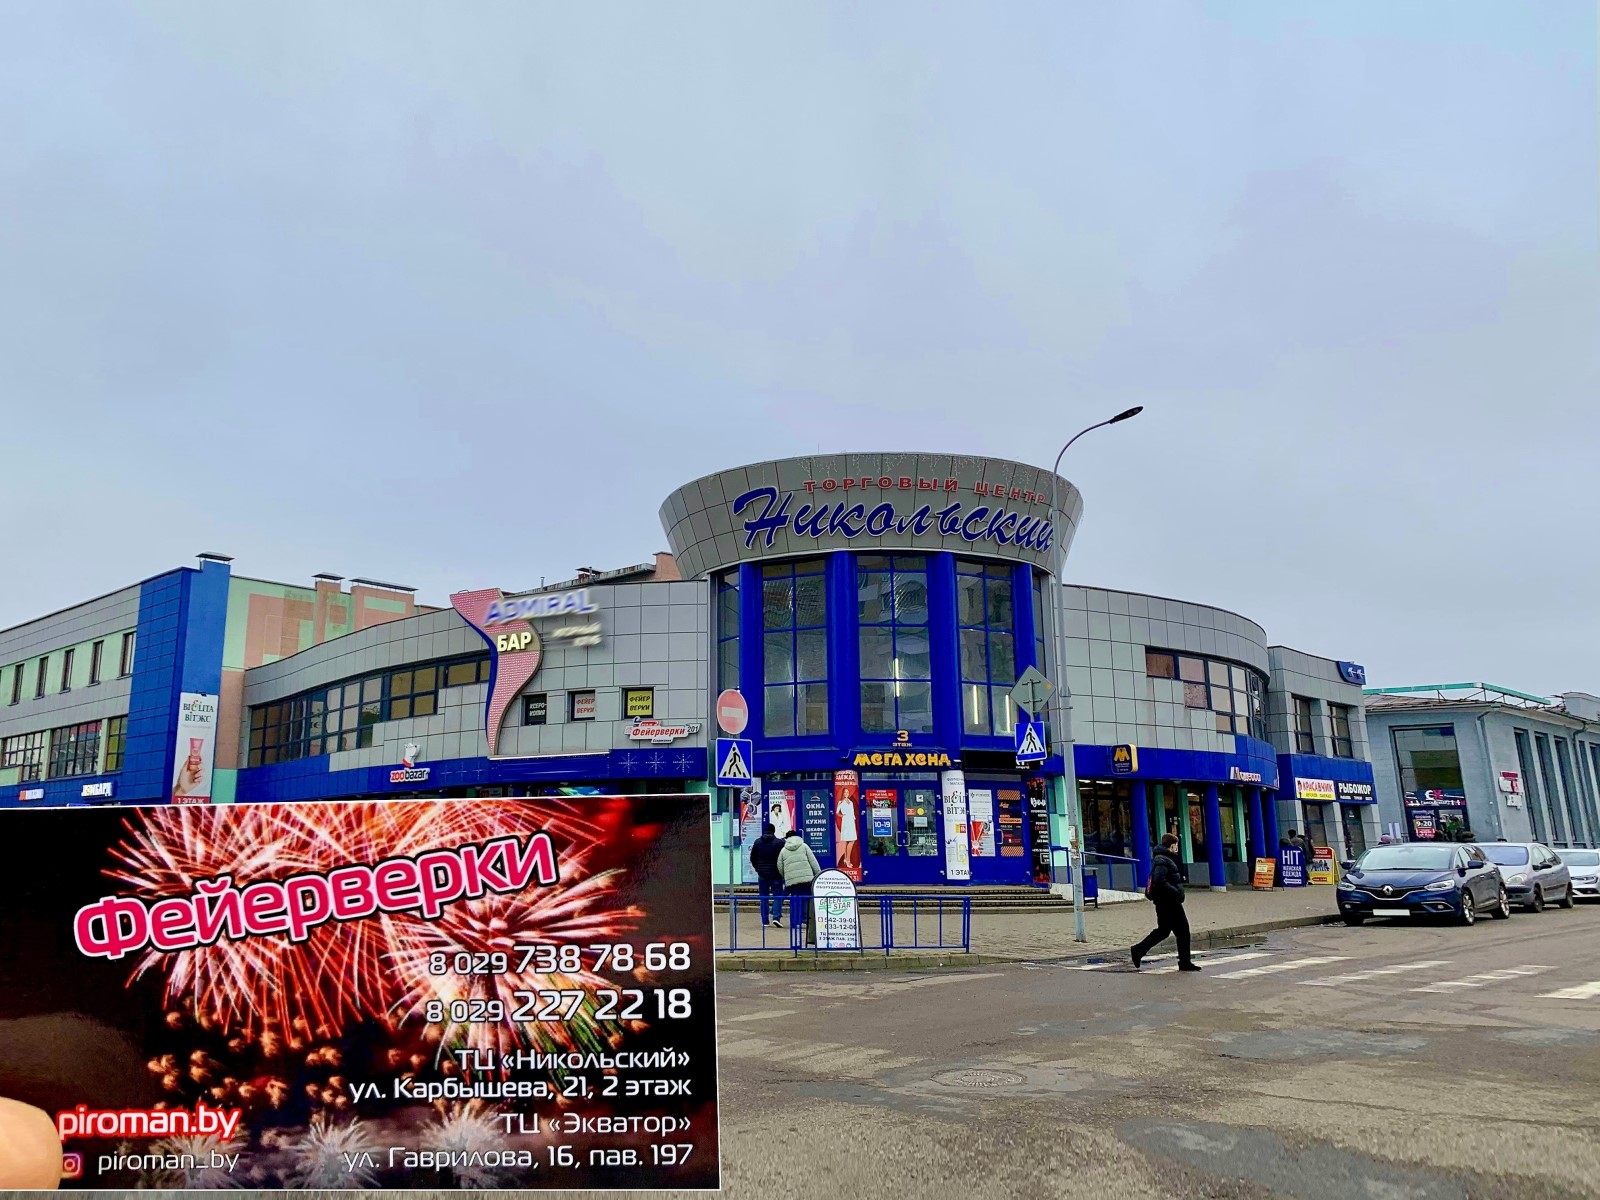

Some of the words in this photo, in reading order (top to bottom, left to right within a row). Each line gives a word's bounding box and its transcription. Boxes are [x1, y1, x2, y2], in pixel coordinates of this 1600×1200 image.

[803, 476, 959, 493] ТОРГОВЫЙ
[974, 481, 1046, 504] ЦЕНТР
[497, 632, 532, 652] БАР
[629, 695, 650, 703] ФЕЙЕР
[632, 726, 685, 737] Фейерверки
[897, 730, 908, 741] 3
[390, 768, 428, 782] zoobazar
[1338, 783, 1371, 795] РЫБОЖОР
[75, 832, 556, 959] Фейерверки
[833, 901, 851, 910] STAR
[429, 952, 447, 975] 8
[454, 952, 507, 975] 029
[513, 945, 581, 973] 738
[589, 943, 634, 972] 78
[645, 942, 691, 971] 68
[426, 1000, 443, 1022] 8
[451, 1000, 504, 1023] 029
[512, 990, 585, 1022] 227
[595, 989, 643, 1020] 22
[654, 988, 692, 1019] 18
[455, 1050, 495, 1070] ТЦ
[502, 1047, 690, 1070] «Никольский»
[349, 1082, 387, 1103] ул.
[394, 1077, 554, 1102] Карбышева,
[563, 1076, 594, 1099] 21,
[602, 1076, 618, 1096] 2
[625, 1078, 692, 1096] этаж
[58, 1105, 240, 1141] piroman.by
[499, 1113, 541, 1134] ТЦ
[549, 1113, 691, 1136] «Экватор»
[98, 1151, 240, 1175] piroman_by
[344, 1150, 380, 1172] ул.
[389, 1147, 539, 1171] Гаврилова,
[548, 1145, 580, 1168] 16,
[589, 1149, 643, 1166] пав.
[652, 1143, 694, 1166] 197
